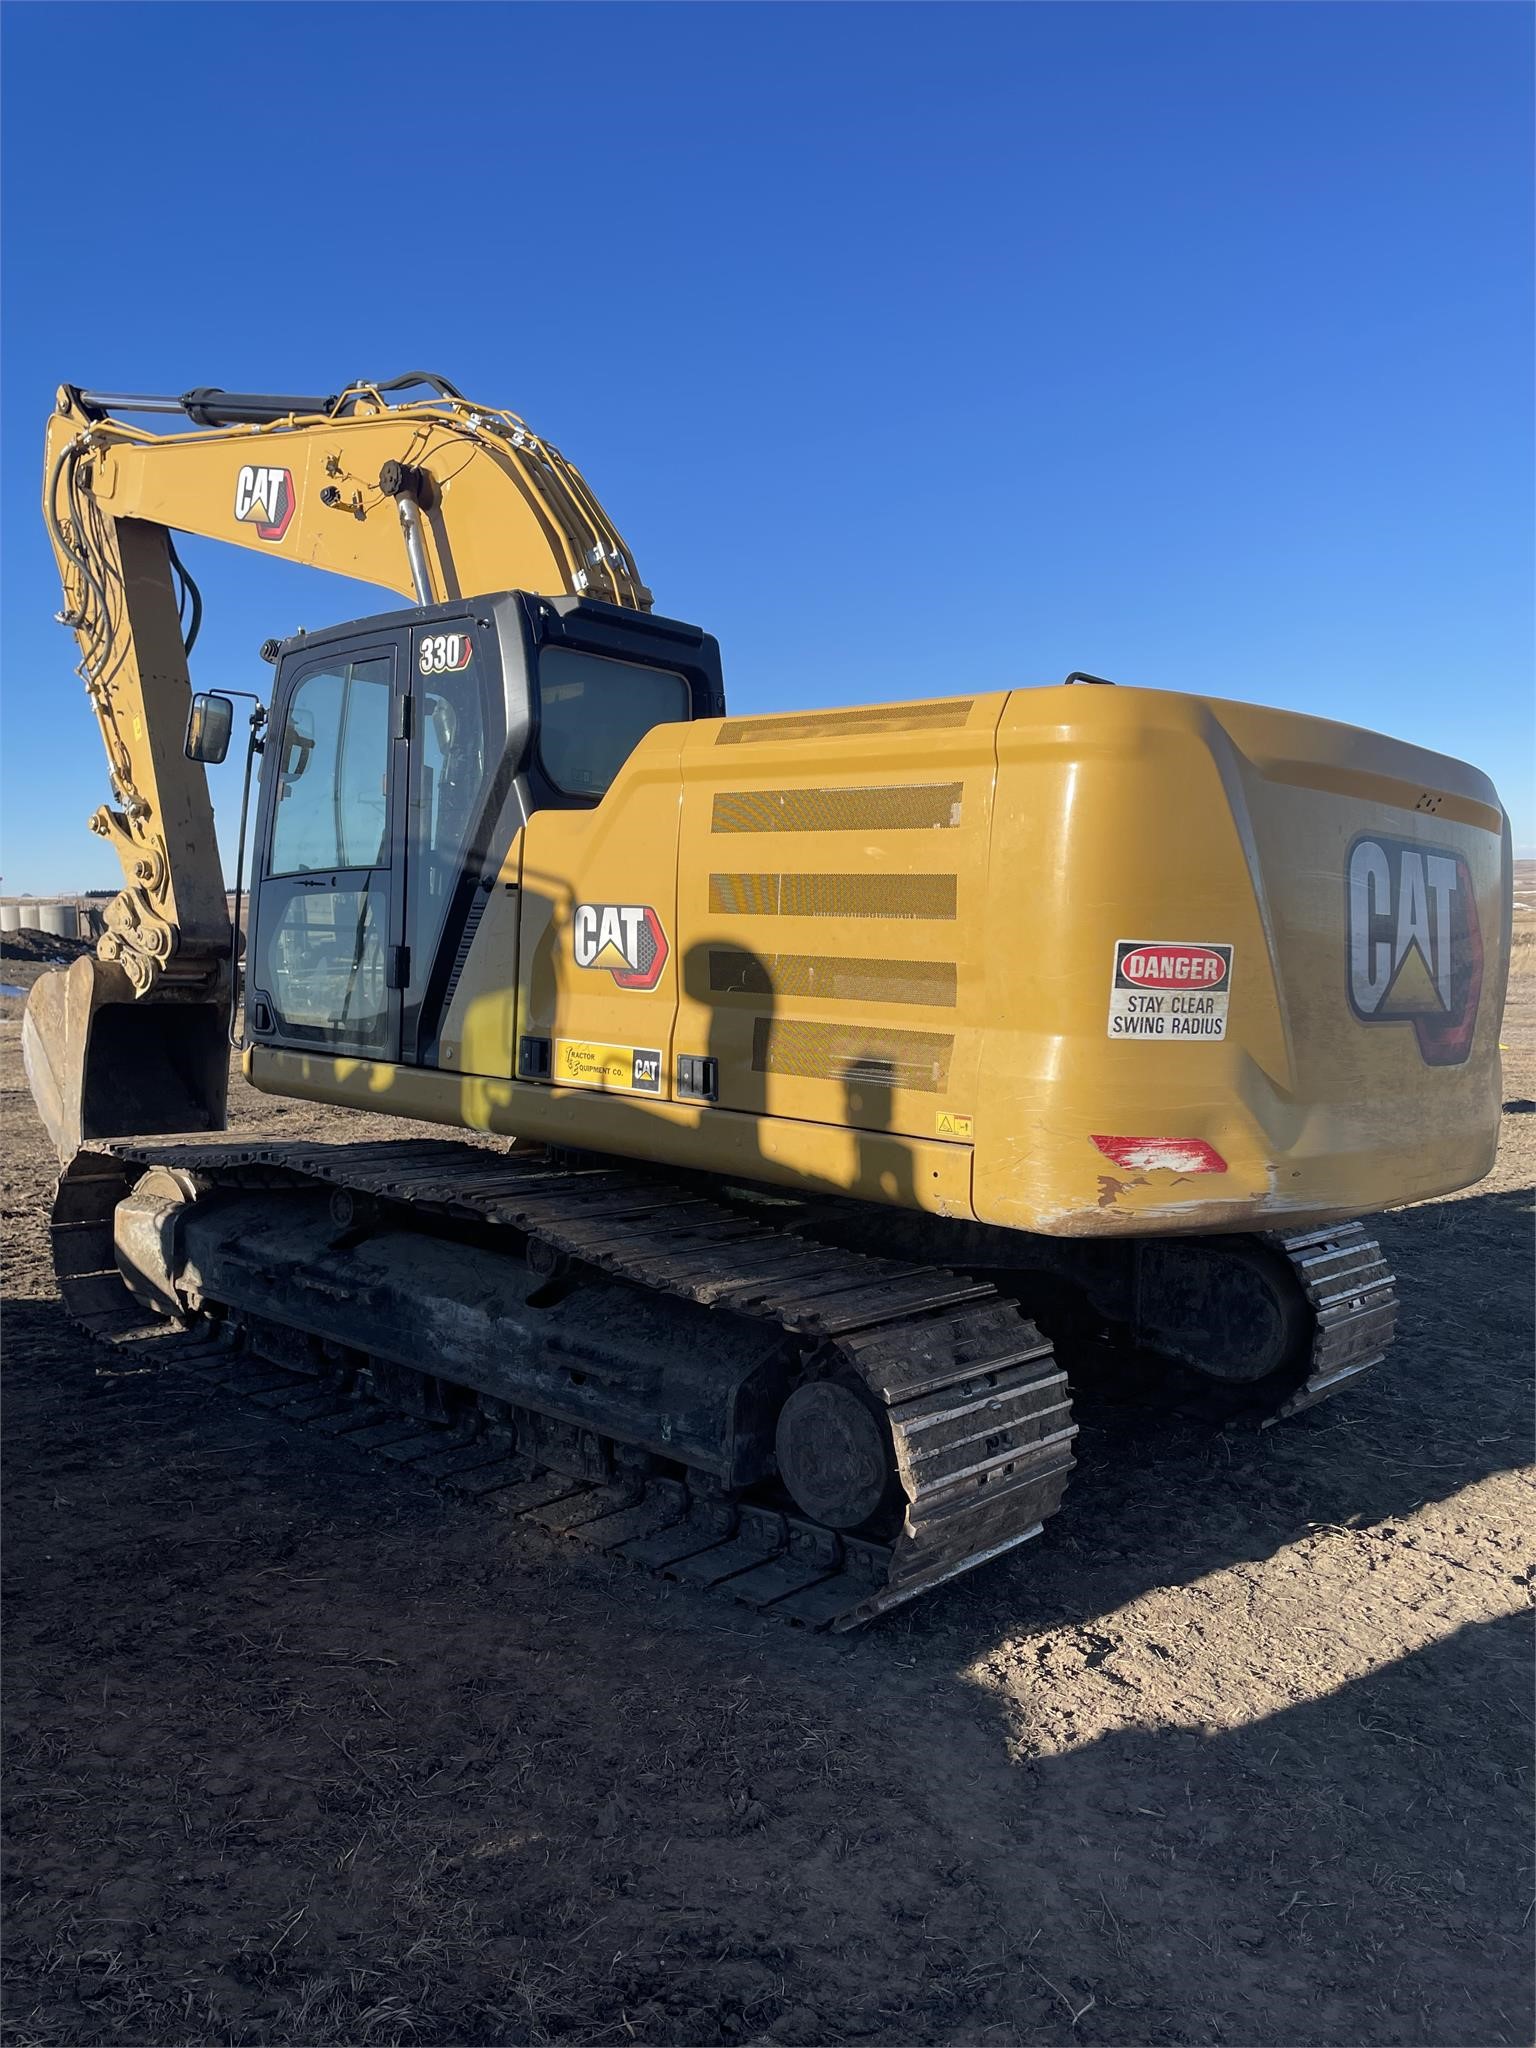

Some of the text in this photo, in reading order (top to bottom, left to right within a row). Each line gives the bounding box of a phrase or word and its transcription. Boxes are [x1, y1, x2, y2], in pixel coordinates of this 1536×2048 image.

[235, 466, 285, 523] CAT
[421, 635, 460, 671] 330
[574, 905, 644, 969] CAT
[1350, 841, 1457, 1014] CAT
[1129, 955, 1219, 980] DANGER
[1127, 996, 1214, 1014] STAY CLEAR
[1113, 1016, 1223, 1035] SWING RADIUS
[566, 1046, 596, 1062] TRACTOR
[573, 1060, 611, 1077] EQUIPMENT
[612, 1068, 625, 1077] CO.
[634, 1058, 657, 1081] CAT
